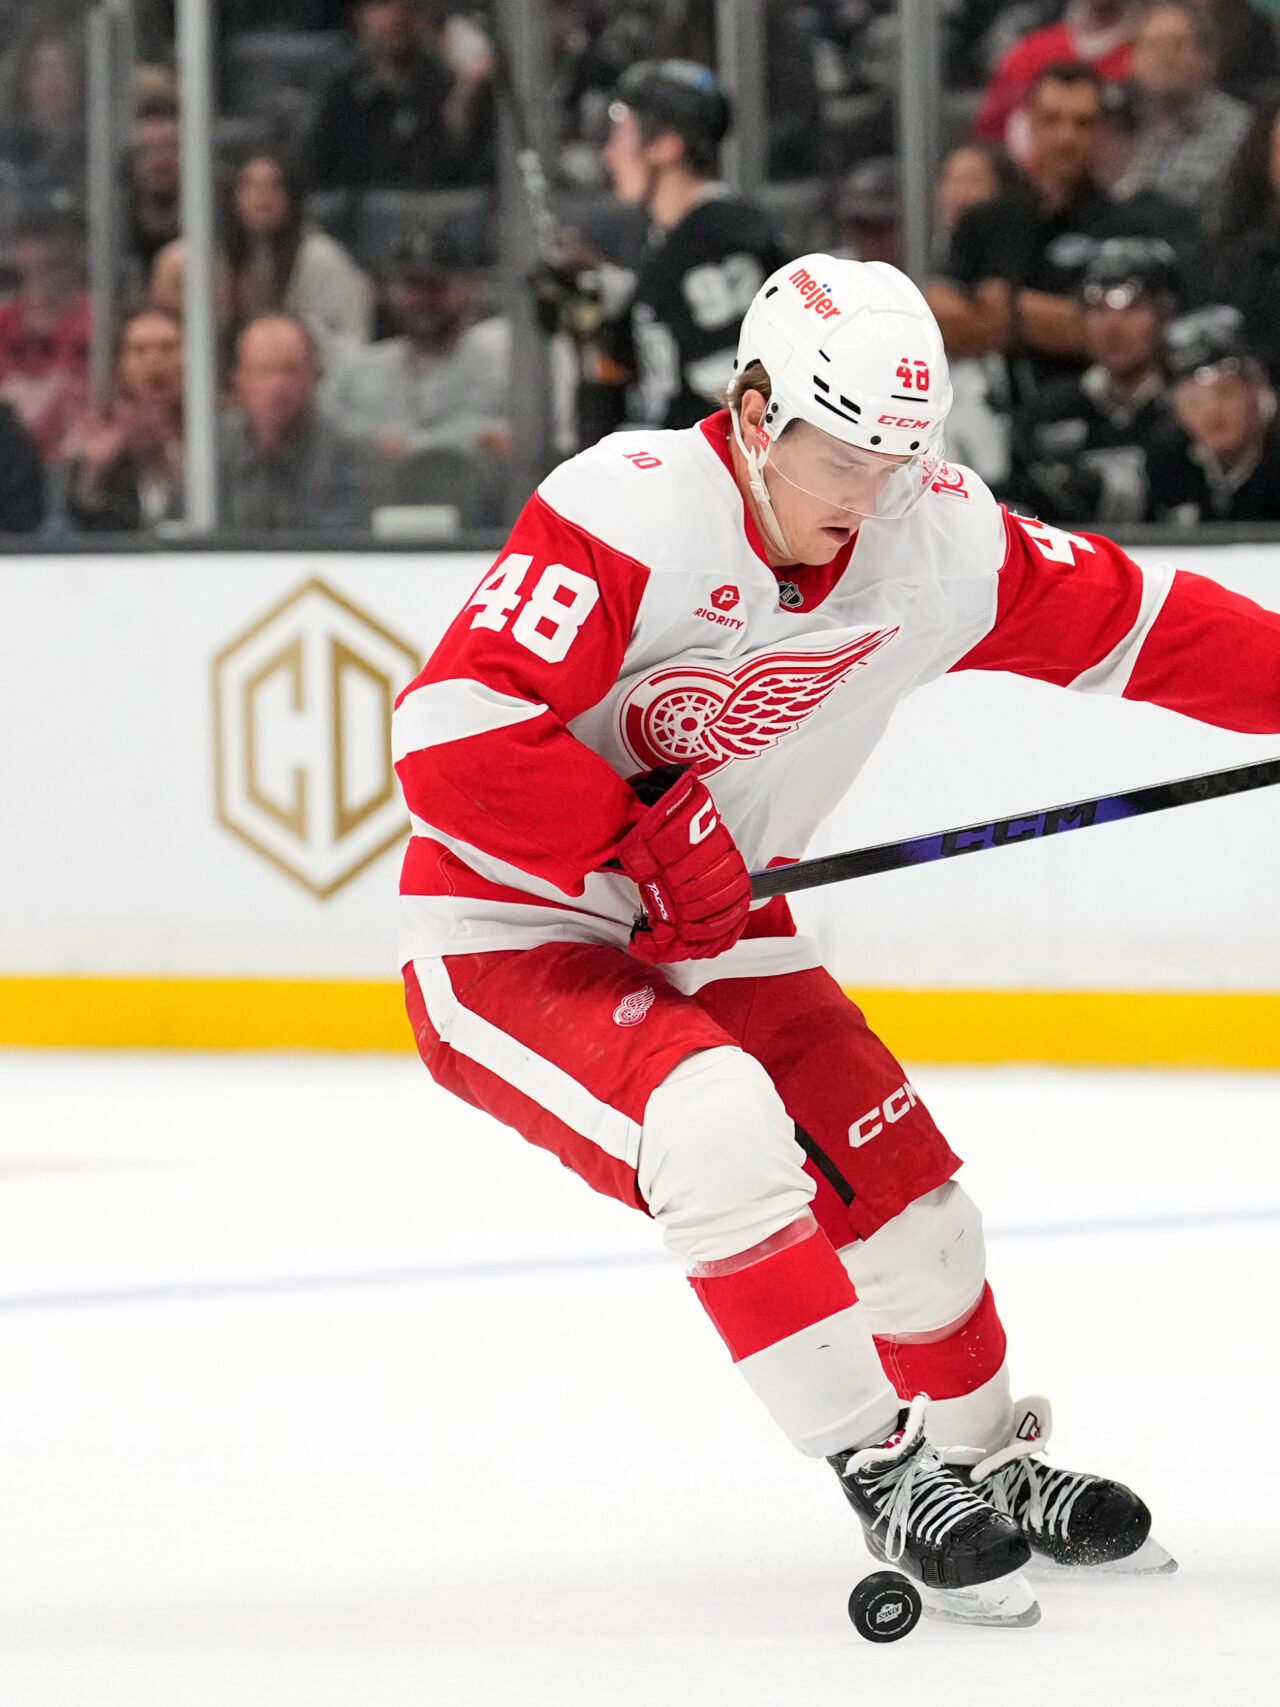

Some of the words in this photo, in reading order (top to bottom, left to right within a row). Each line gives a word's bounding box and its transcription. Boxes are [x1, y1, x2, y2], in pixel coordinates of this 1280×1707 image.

[789, 268, 842, 320] meijer
[877, 415, 932, 430] CCM
[622, 451, 663, 469] 10
[464, 553, 599, 663] 48
[781, 588, 795, 602] NHL
[938, 801, 1098, 857] CCM
